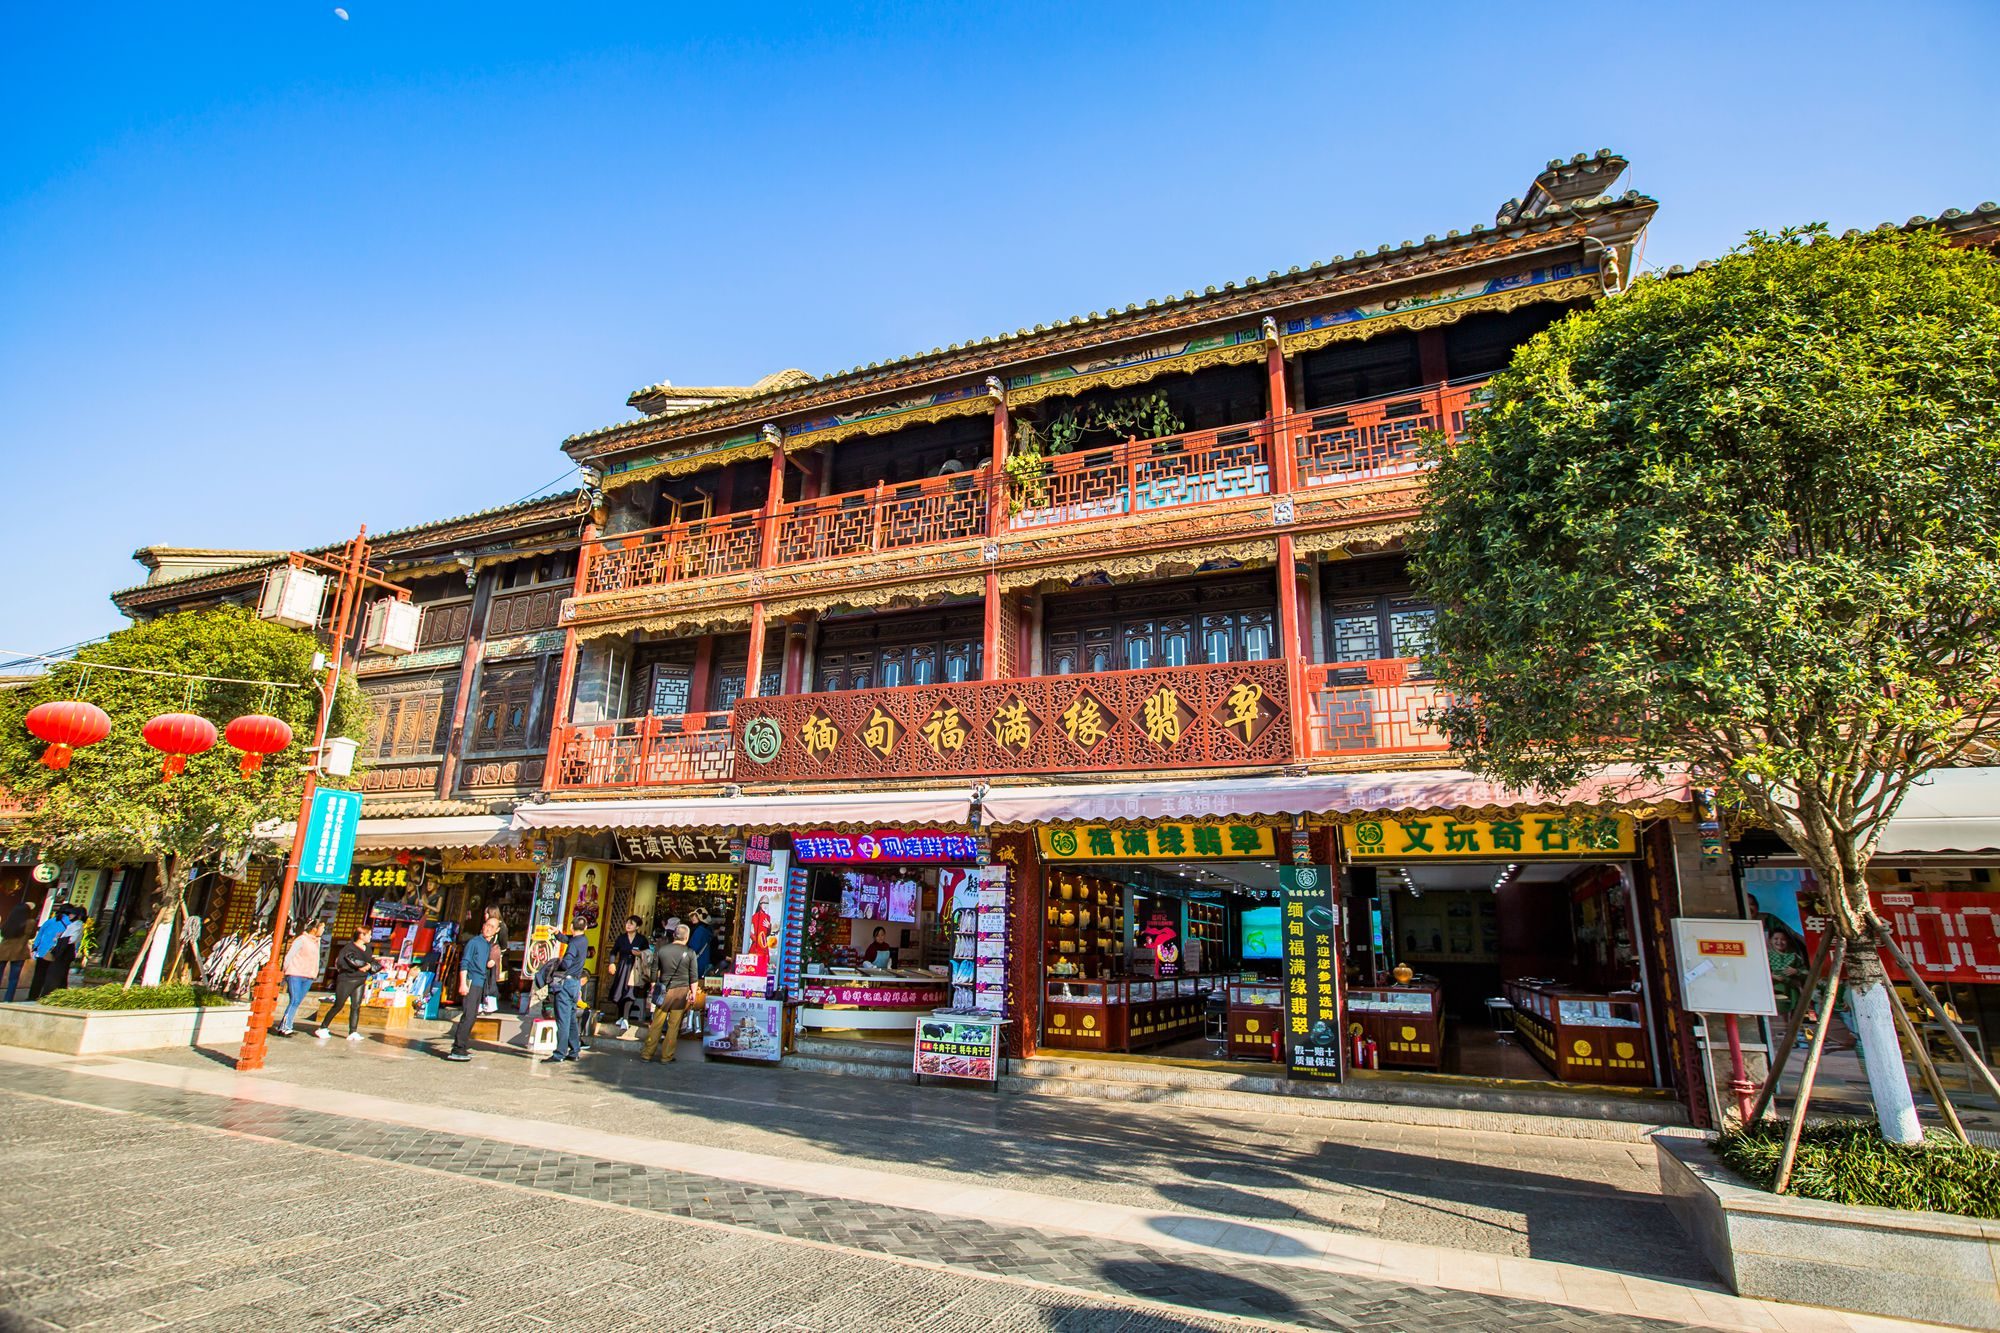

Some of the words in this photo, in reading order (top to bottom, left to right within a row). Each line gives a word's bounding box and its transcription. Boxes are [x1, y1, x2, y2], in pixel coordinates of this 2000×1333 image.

[802, 684, 1262, 756] 缅甸福满缘翡翠
[626, 834, 731, 860] 古滇民俗工艺
[1088, 824, 1262, 856] 福满缘翡翠
[1287, 902, 1309, 1035] 缅甸福满缘翡翠
[1316, 934, 1334, 1020] 欢迎您参观选购
[932, 1042, 957, 1054] 牛肉干巴
[959, 1043, 991, 1057] 牦牛肉干巴
[1294, 1045, 1335, 1057] 假一赔十
[1295, 1056, 1336, 1067] 质量保证
